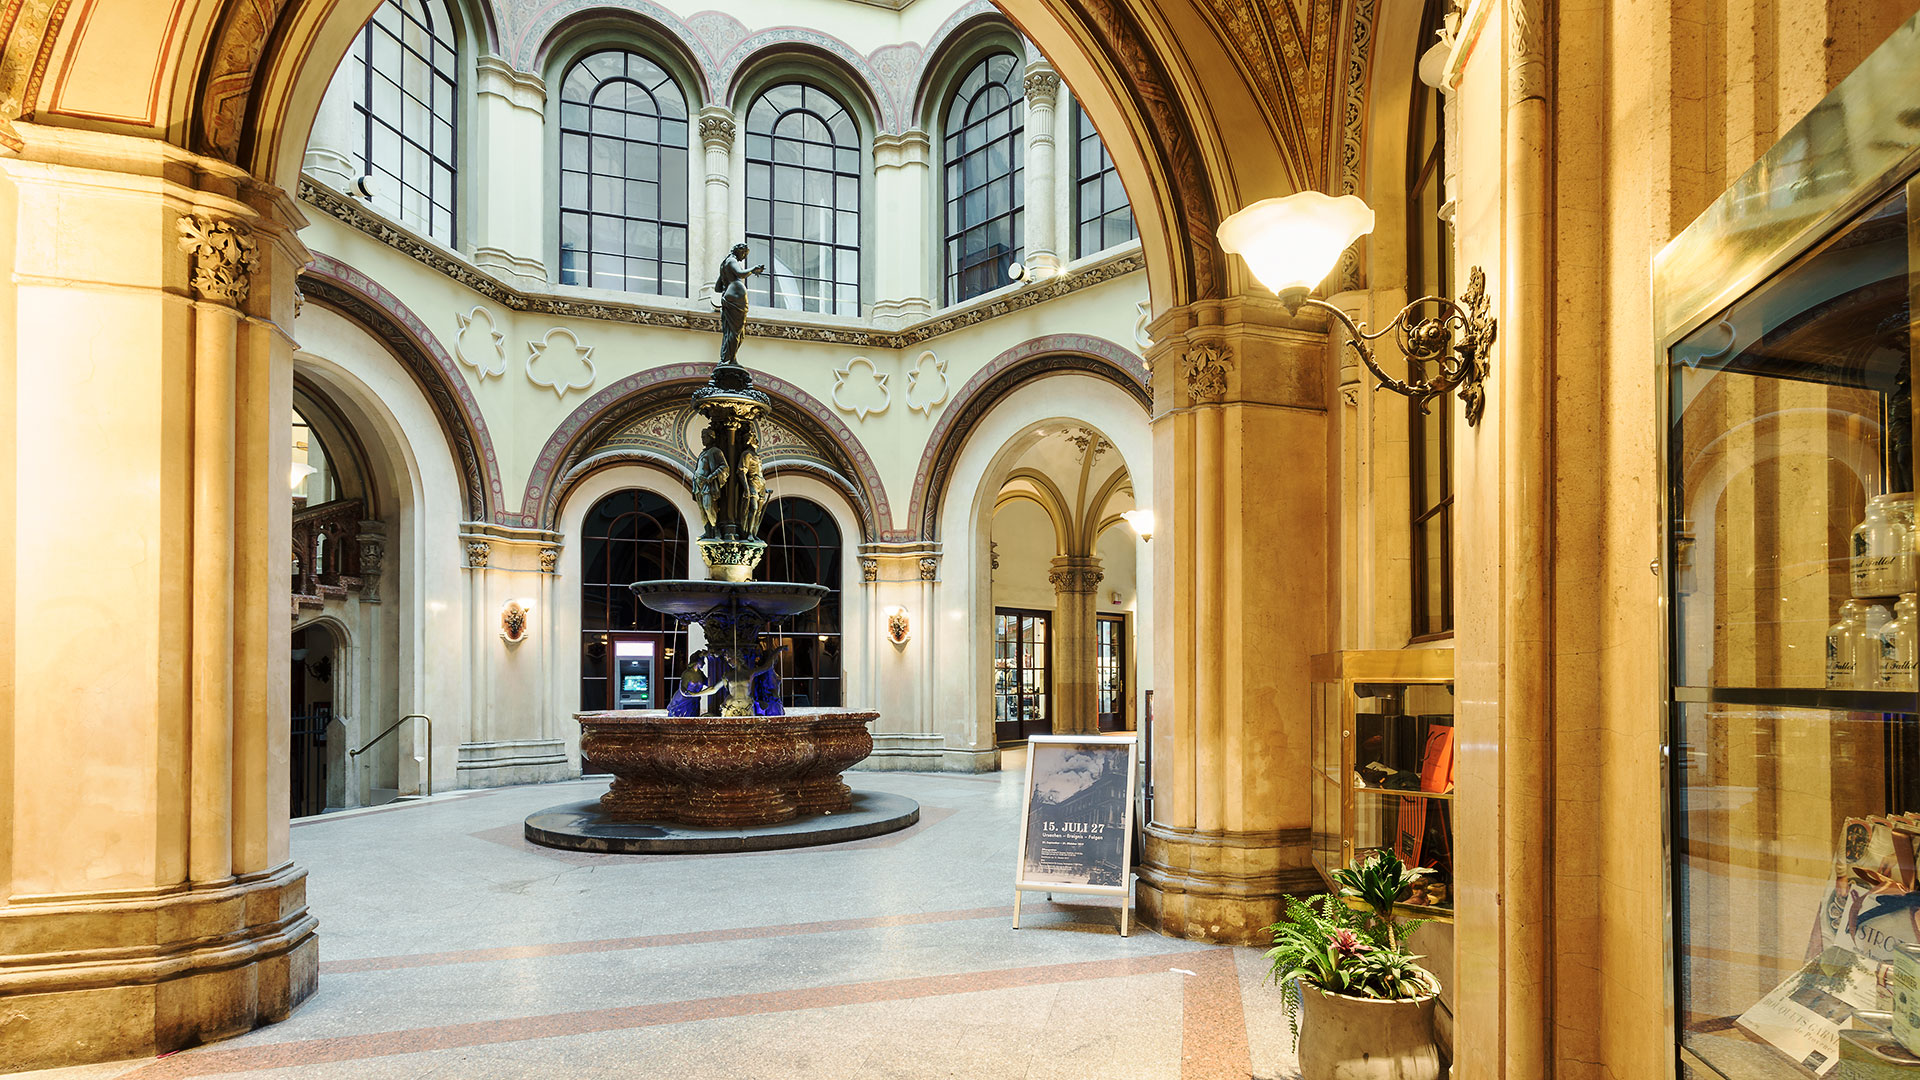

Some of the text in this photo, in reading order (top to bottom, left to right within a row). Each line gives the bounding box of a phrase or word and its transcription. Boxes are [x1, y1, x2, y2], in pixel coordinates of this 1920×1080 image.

[1043, 821, 1105, 834] 15. JULI 27
